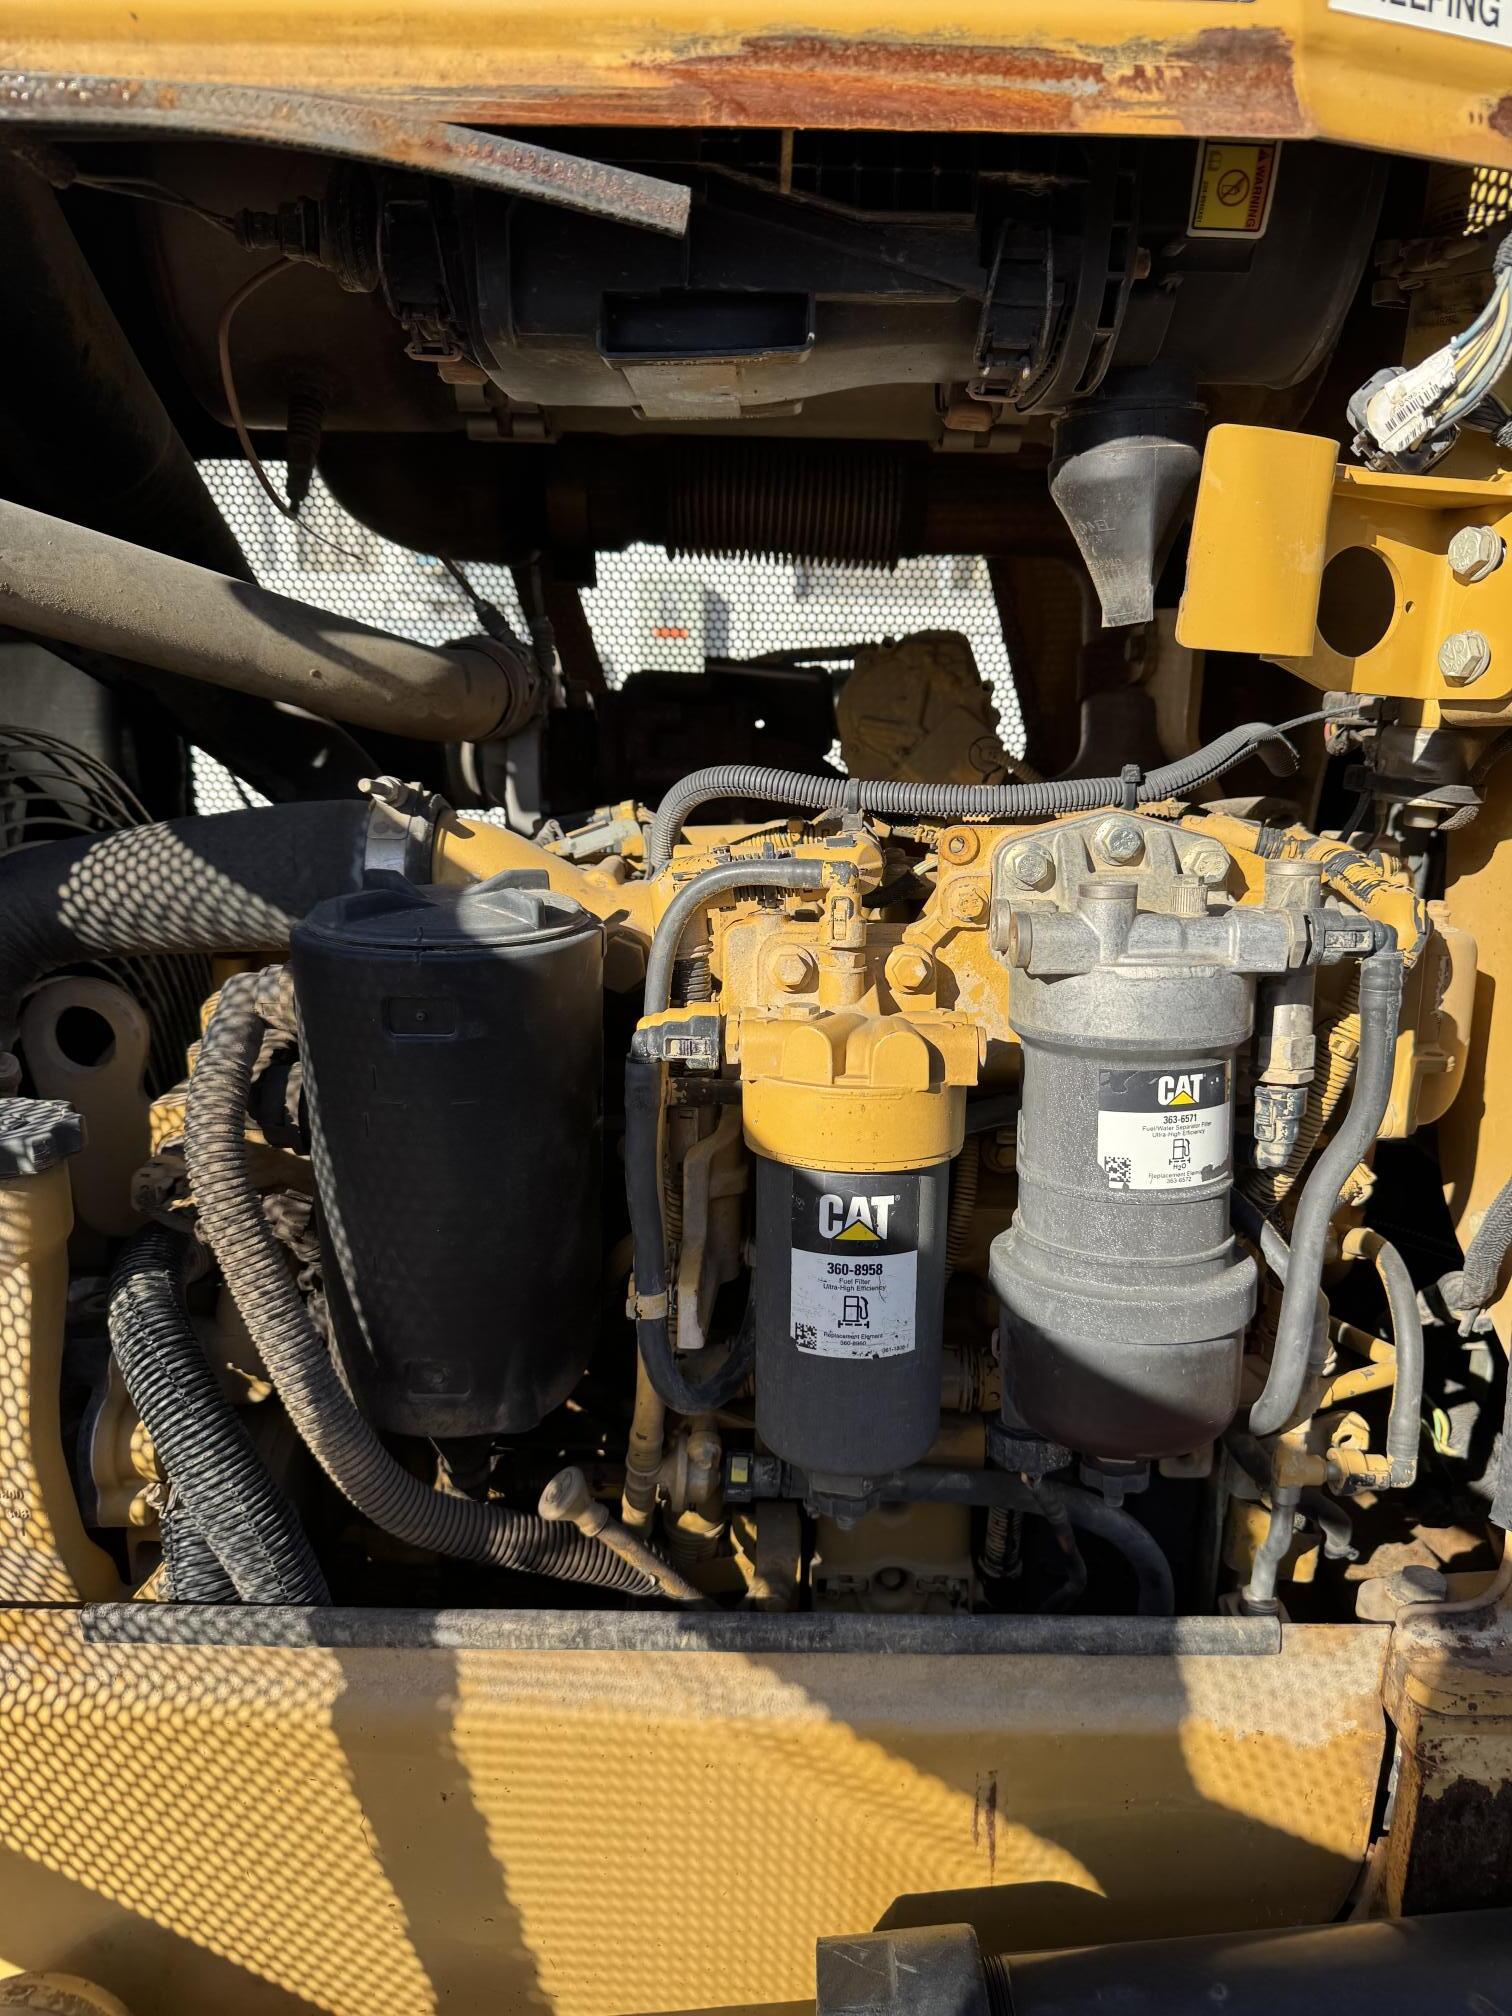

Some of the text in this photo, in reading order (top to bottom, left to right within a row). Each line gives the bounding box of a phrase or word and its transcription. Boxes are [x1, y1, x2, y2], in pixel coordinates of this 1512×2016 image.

[1247, 166, 1265, 227] WARNING
[1158, 1073, 1204, 1106] CAT
[1163, 1114, 1197, 1124] 363-6571
[1175, 1122, 1200, 1131] Separator
[1148, 1171, 1185, 1180] Replacement
[827, 1262, 883, 1275] 360-8958
[823, 1283, 887, 1292] Ultra-High Efficiency
[823, 1331, 860, 1340] Replacement
